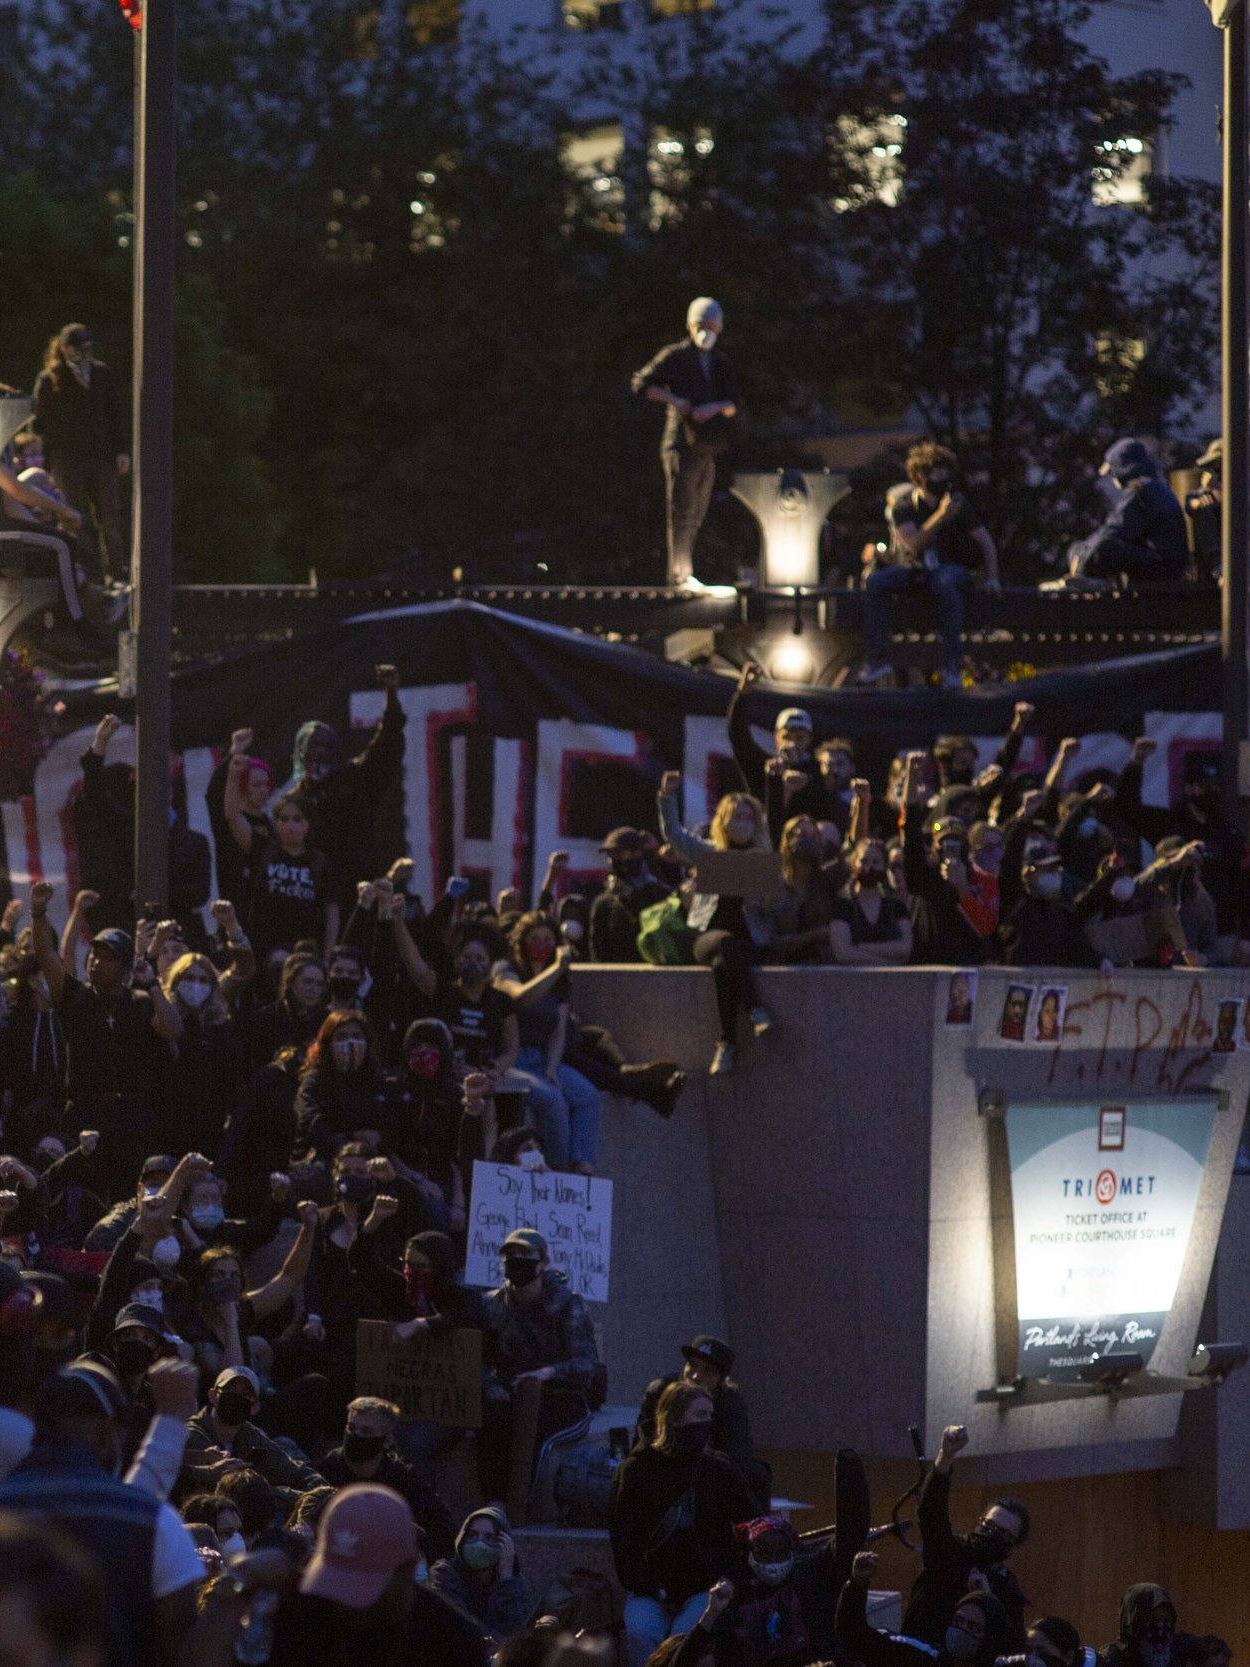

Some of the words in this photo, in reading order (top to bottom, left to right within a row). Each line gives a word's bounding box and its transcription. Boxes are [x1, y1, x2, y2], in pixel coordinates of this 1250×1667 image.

[496, 1166, 523, 1208] Say
[1066, 1213, 1098, 1226] TICKET
[1100, 1212, 1134, 1225] OFFICE
[1137, 1212, 1149, 1223] AT
[1029, 1231, 1072, 1244] PIONEER
[1075, 1229, 1138, 1242] COURTHOUSE
[1140, 1227, 1177, 1240] SQUARE
[1120, 1320, 1157, 1344] Room
